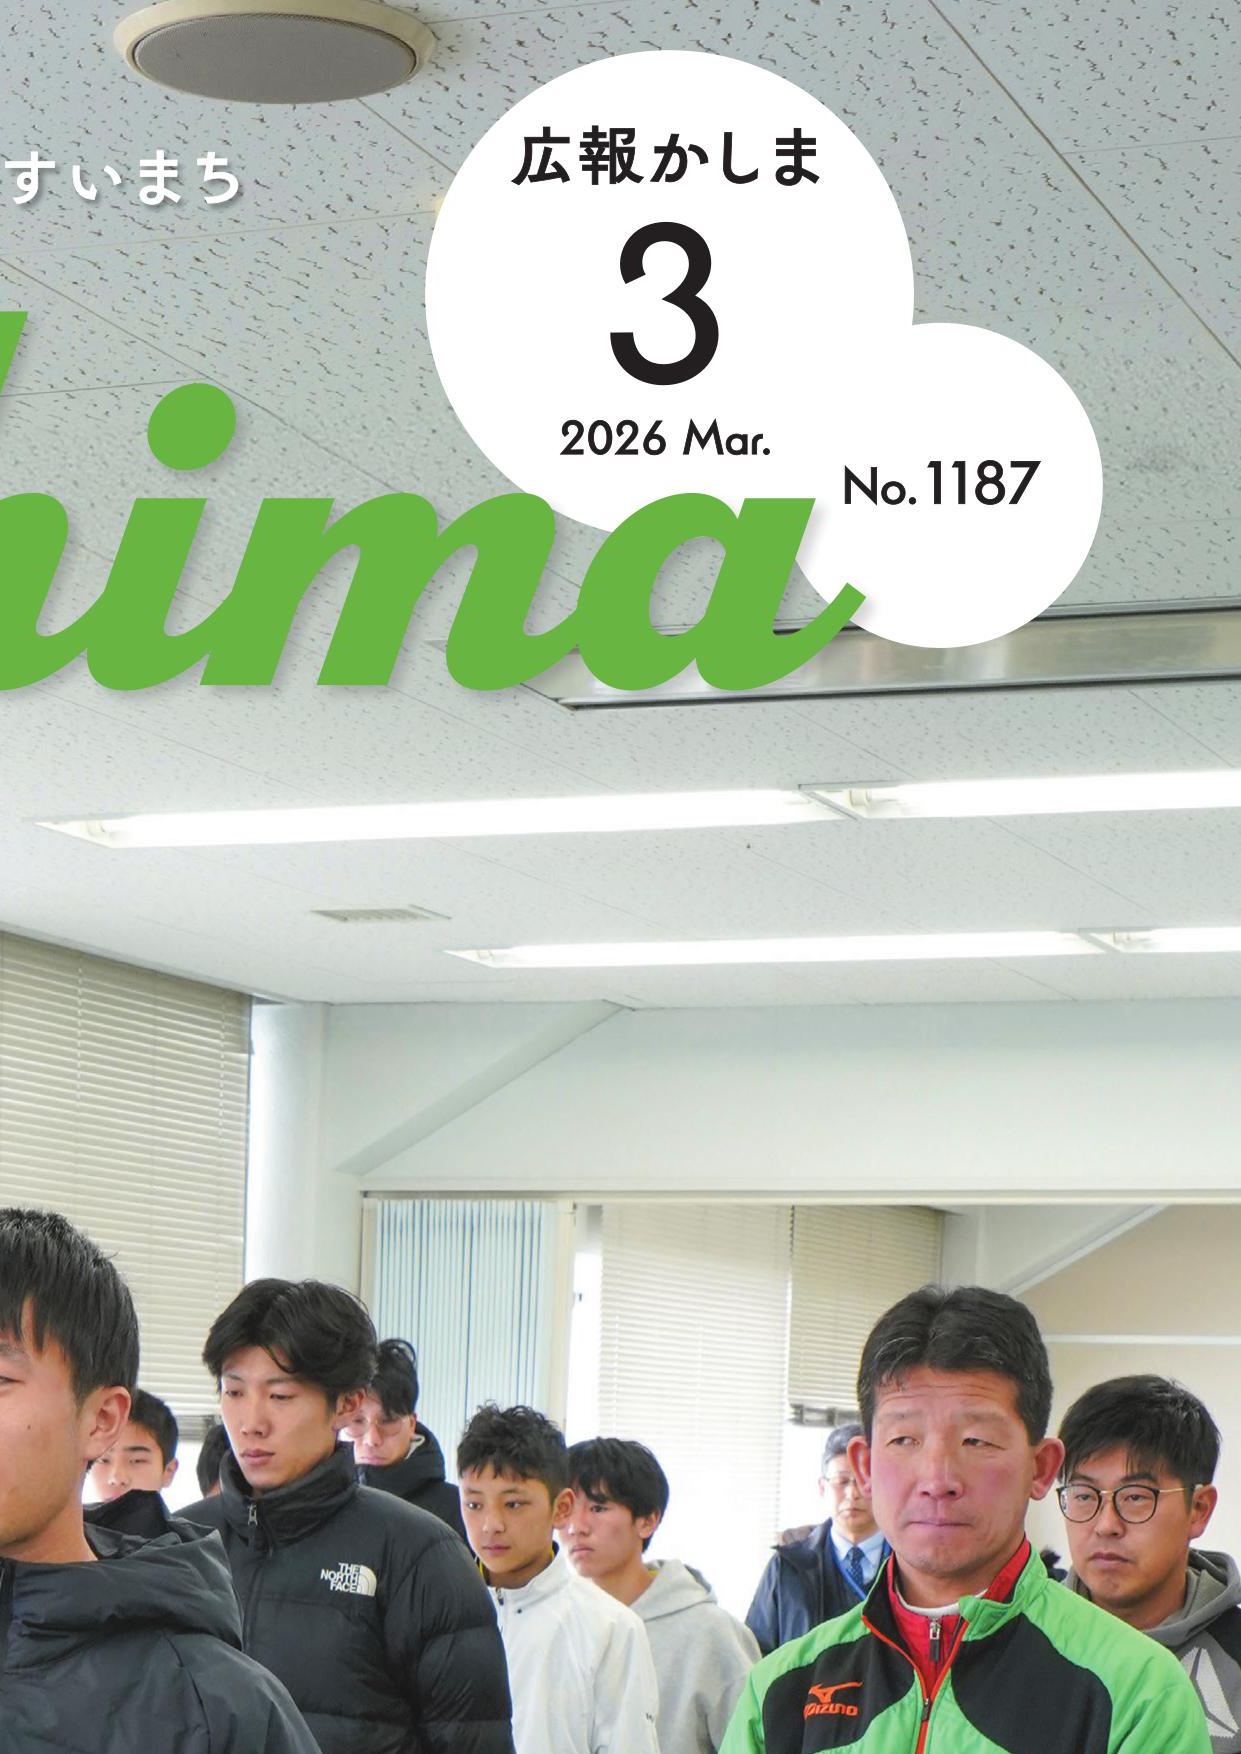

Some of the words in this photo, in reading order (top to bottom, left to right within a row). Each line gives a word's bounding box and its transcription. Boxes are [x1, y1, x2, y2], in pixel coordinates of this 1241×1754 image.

[338, 1562, 360, 1574] THE
[320, 1569, 358, 1585] NORTH
[330, 1580, 359, 1594] FACE
